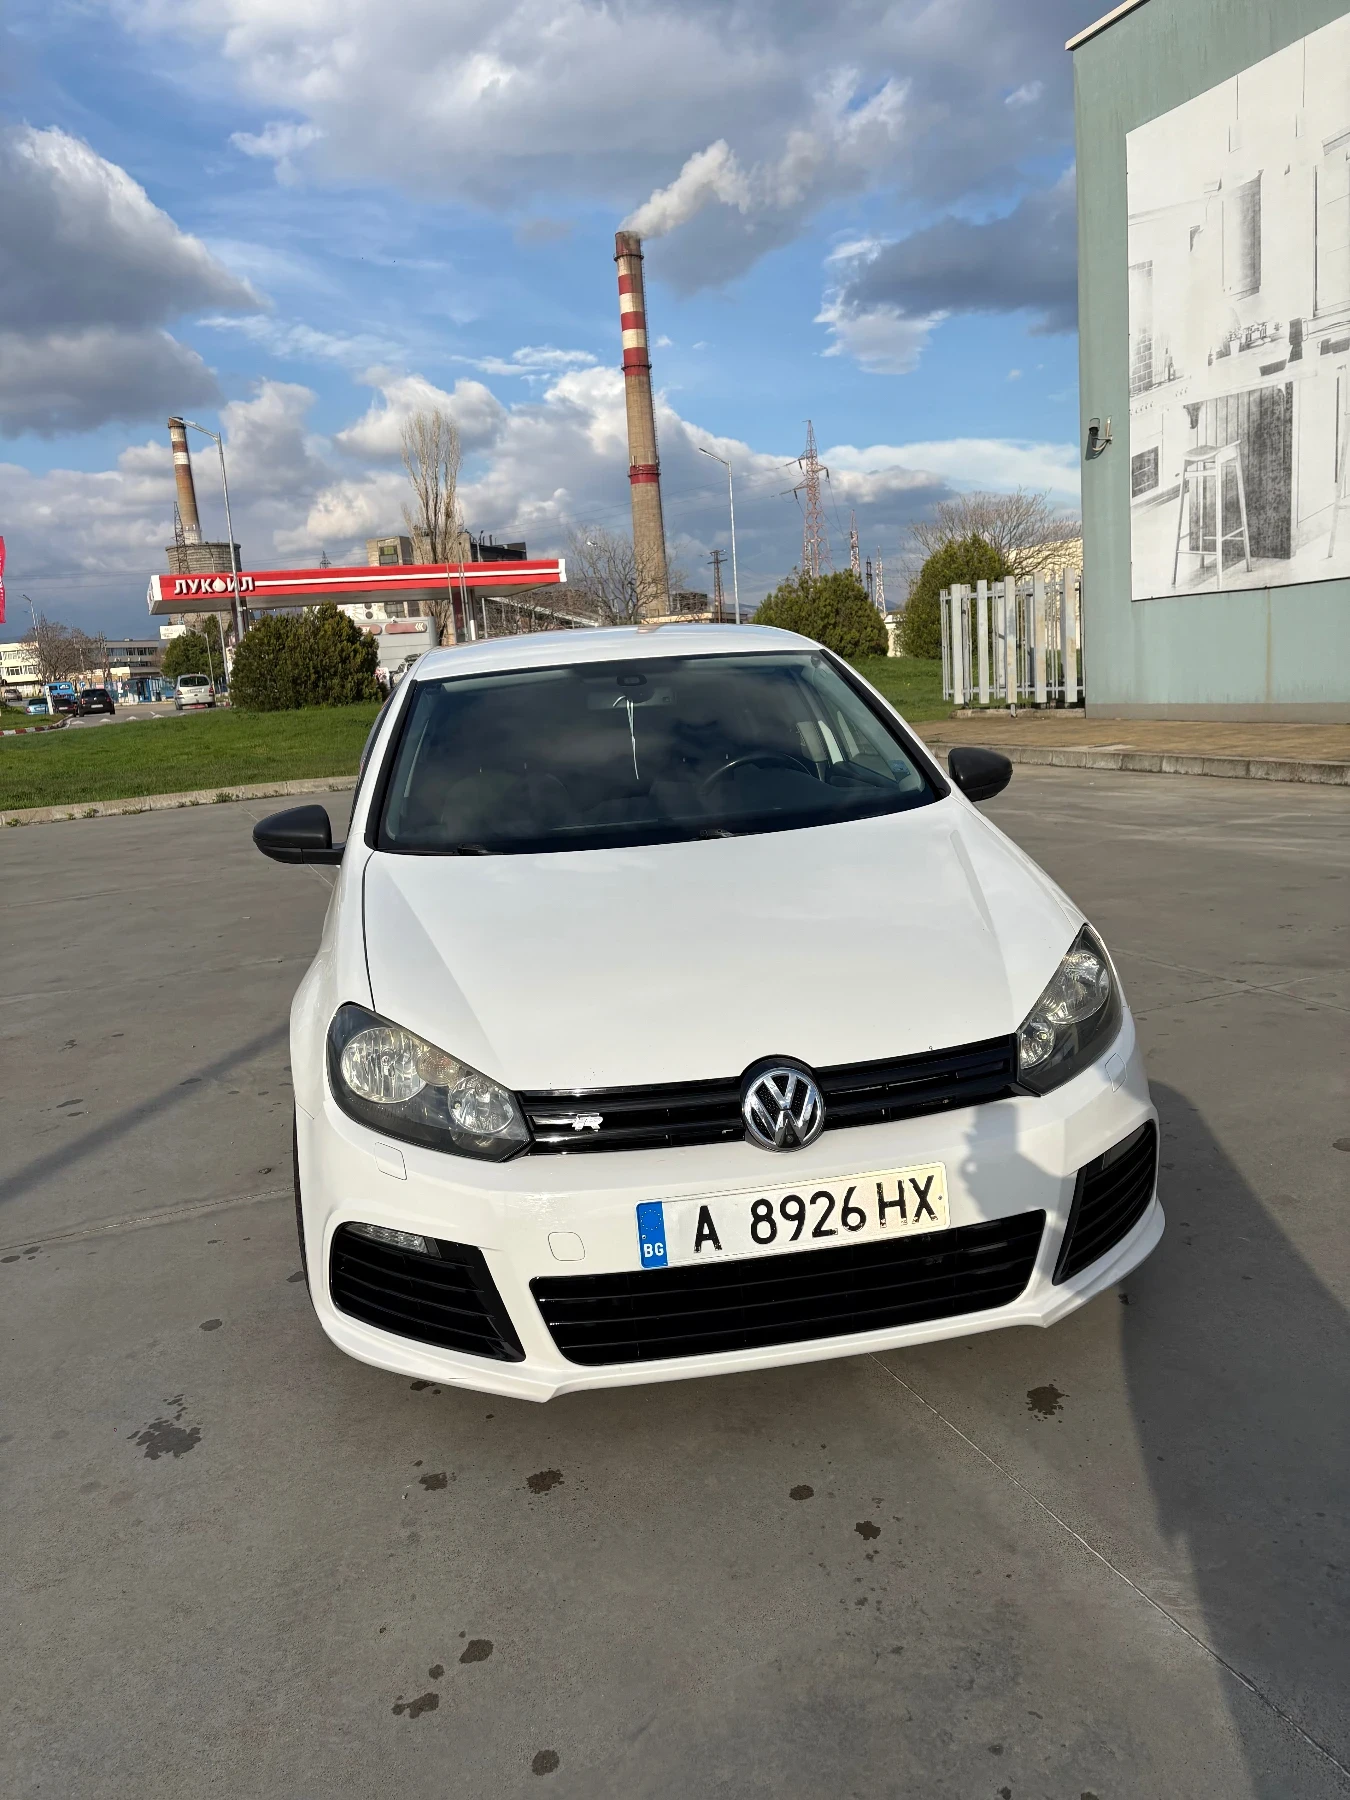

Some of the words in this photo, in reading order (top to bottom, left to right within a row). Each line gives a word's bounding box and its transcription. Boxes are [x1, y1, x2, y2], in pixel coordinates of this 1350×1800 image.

[694, 1205, 722, 1254] A
[750, 1186, 867, 1245] 8926
[876, 1175, 936, 1228] HX
[643, 1242, 664, 1258] BG
